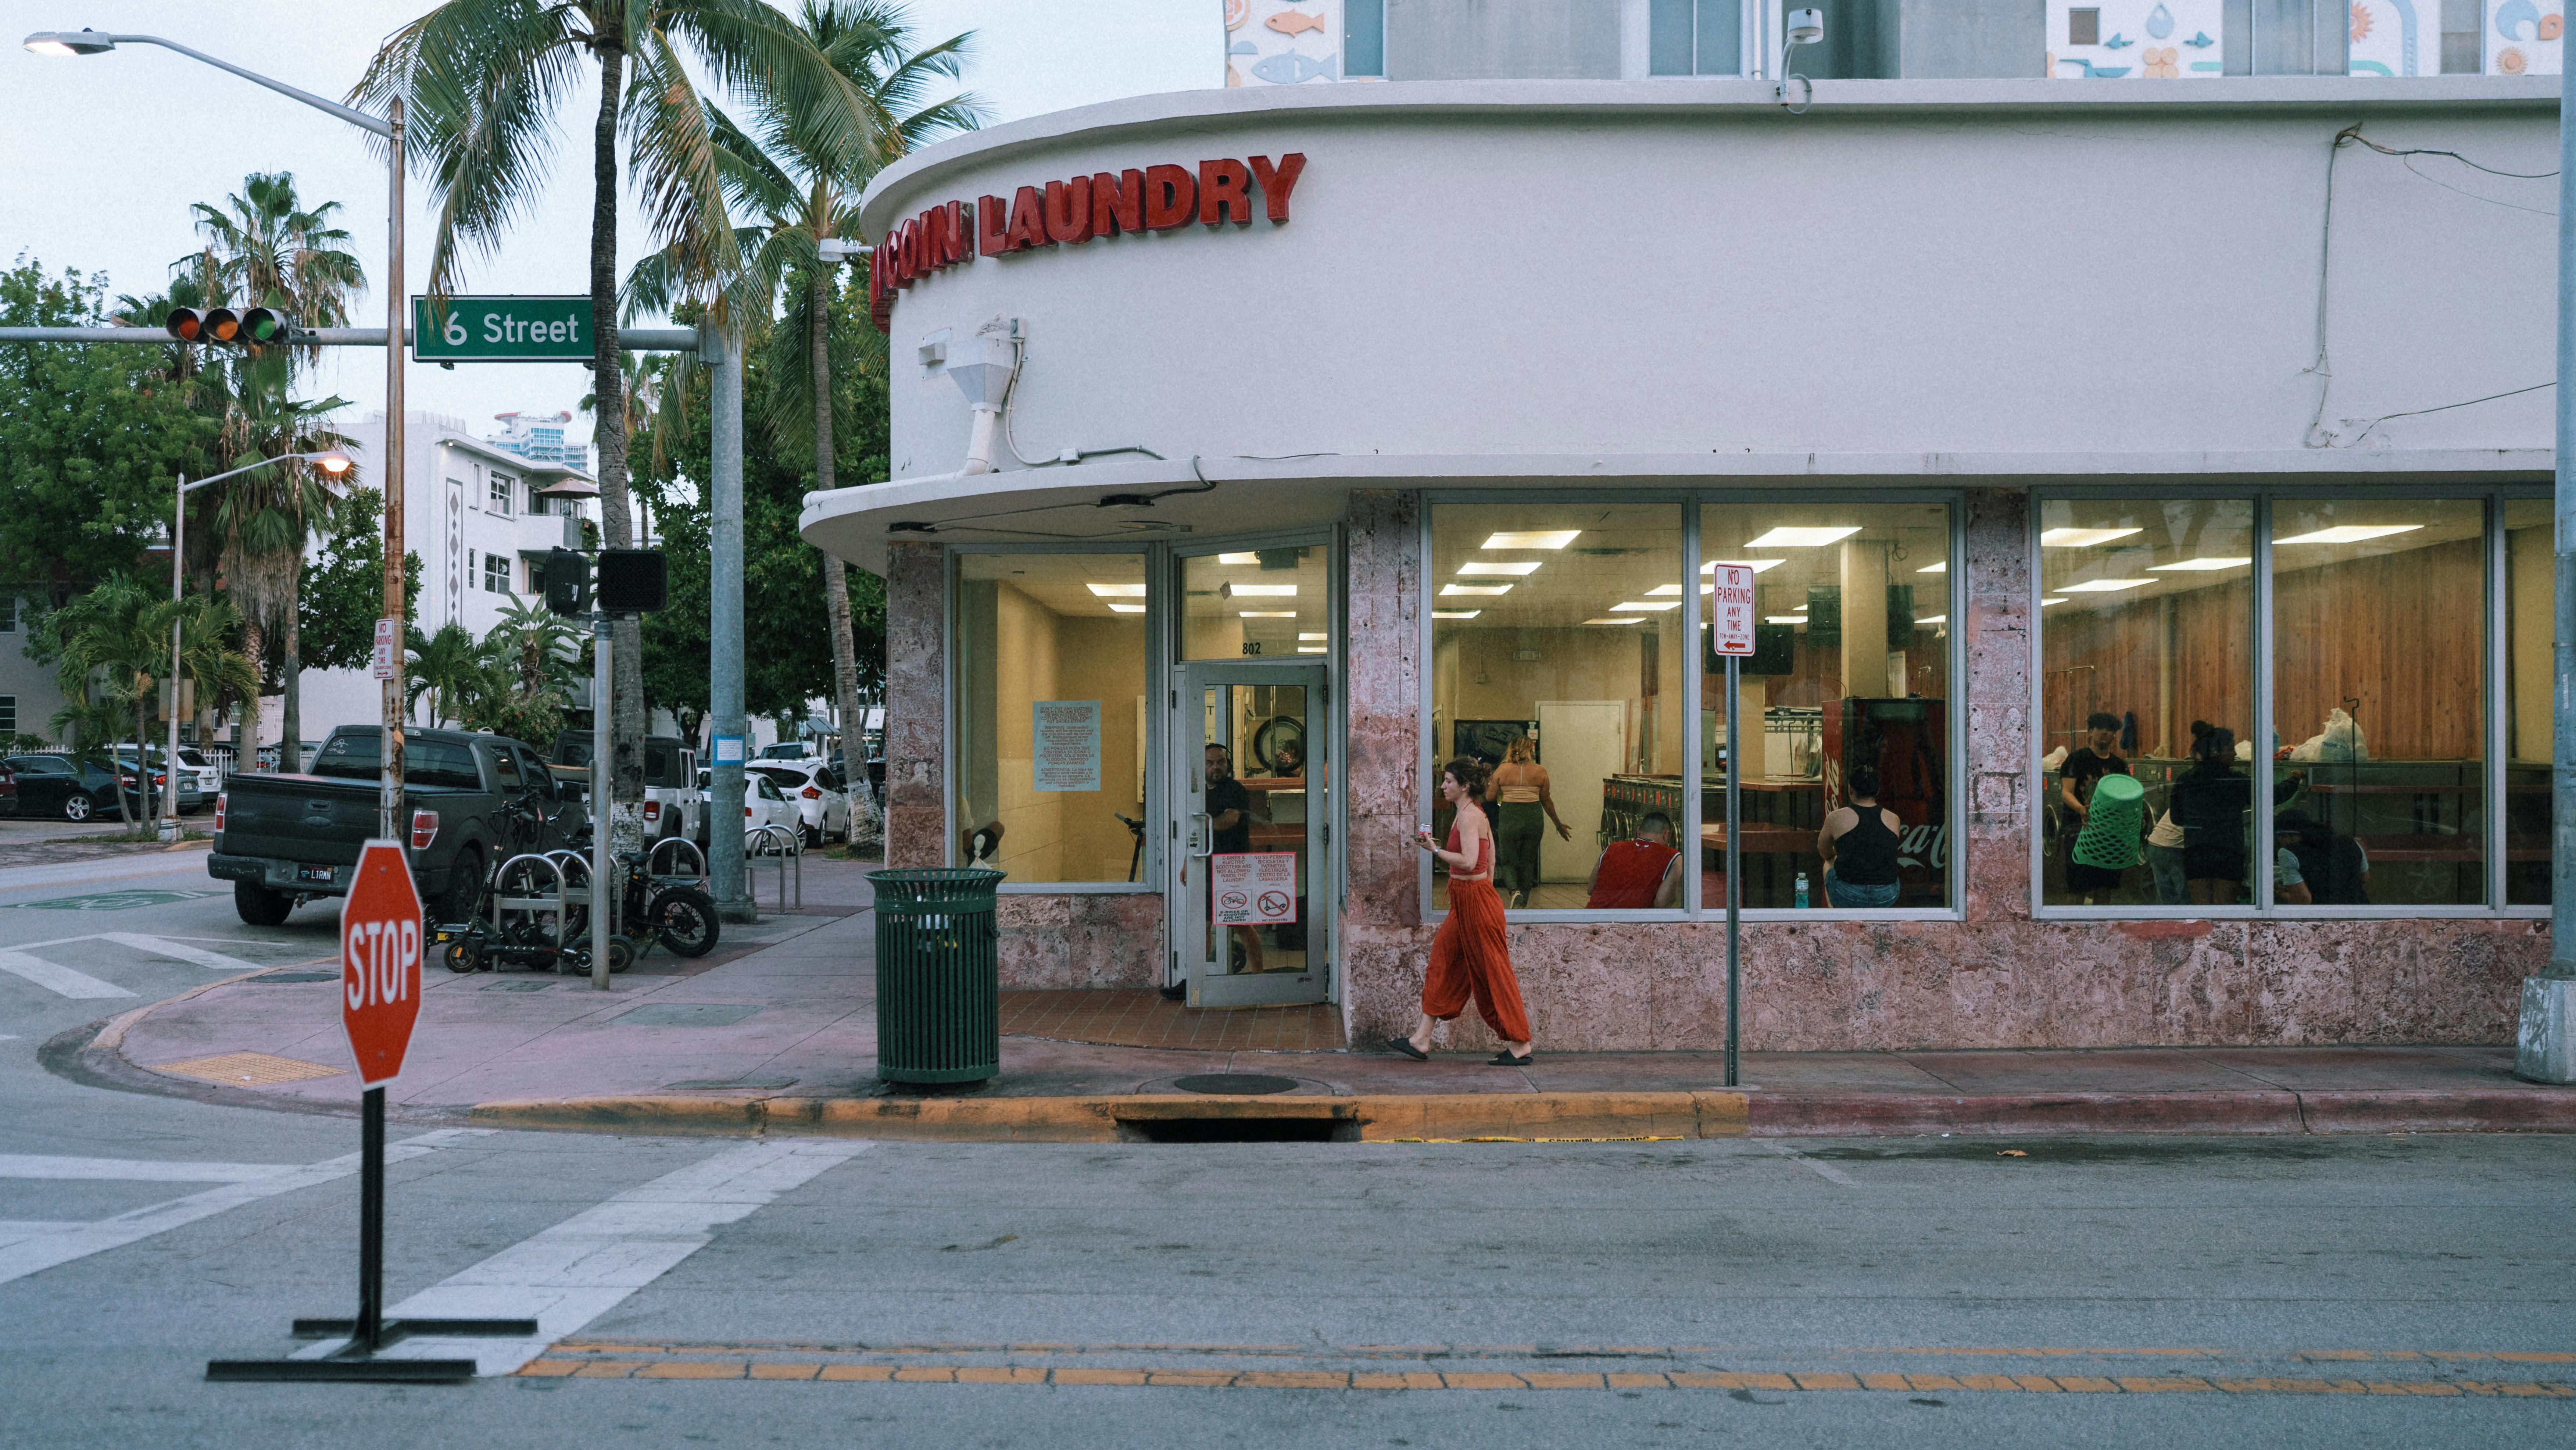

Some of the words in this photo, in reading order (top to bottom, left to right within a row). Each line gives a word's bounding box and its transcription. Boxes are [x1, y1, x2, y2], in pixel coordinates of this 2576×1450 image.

[884, 200, 974, 289] COIN
[978, 153, 1307, 258] LAUNDRY
[444, 311, 467, 346] 6
[483, 313, 579, 343] Street
[1728, 569, 1739, 585] NO
[1718, 587, 1750, 604] PARKING
[1727, 606, 1740, 617] ANY
[379, 623, 386, 633] NO
[1727, 620, 1741, 631] TIME
[376, 635, 391, 645] PARKING
[1243, 642, 1260, 654] 802
[347, 919, 417, 1011] STOP
